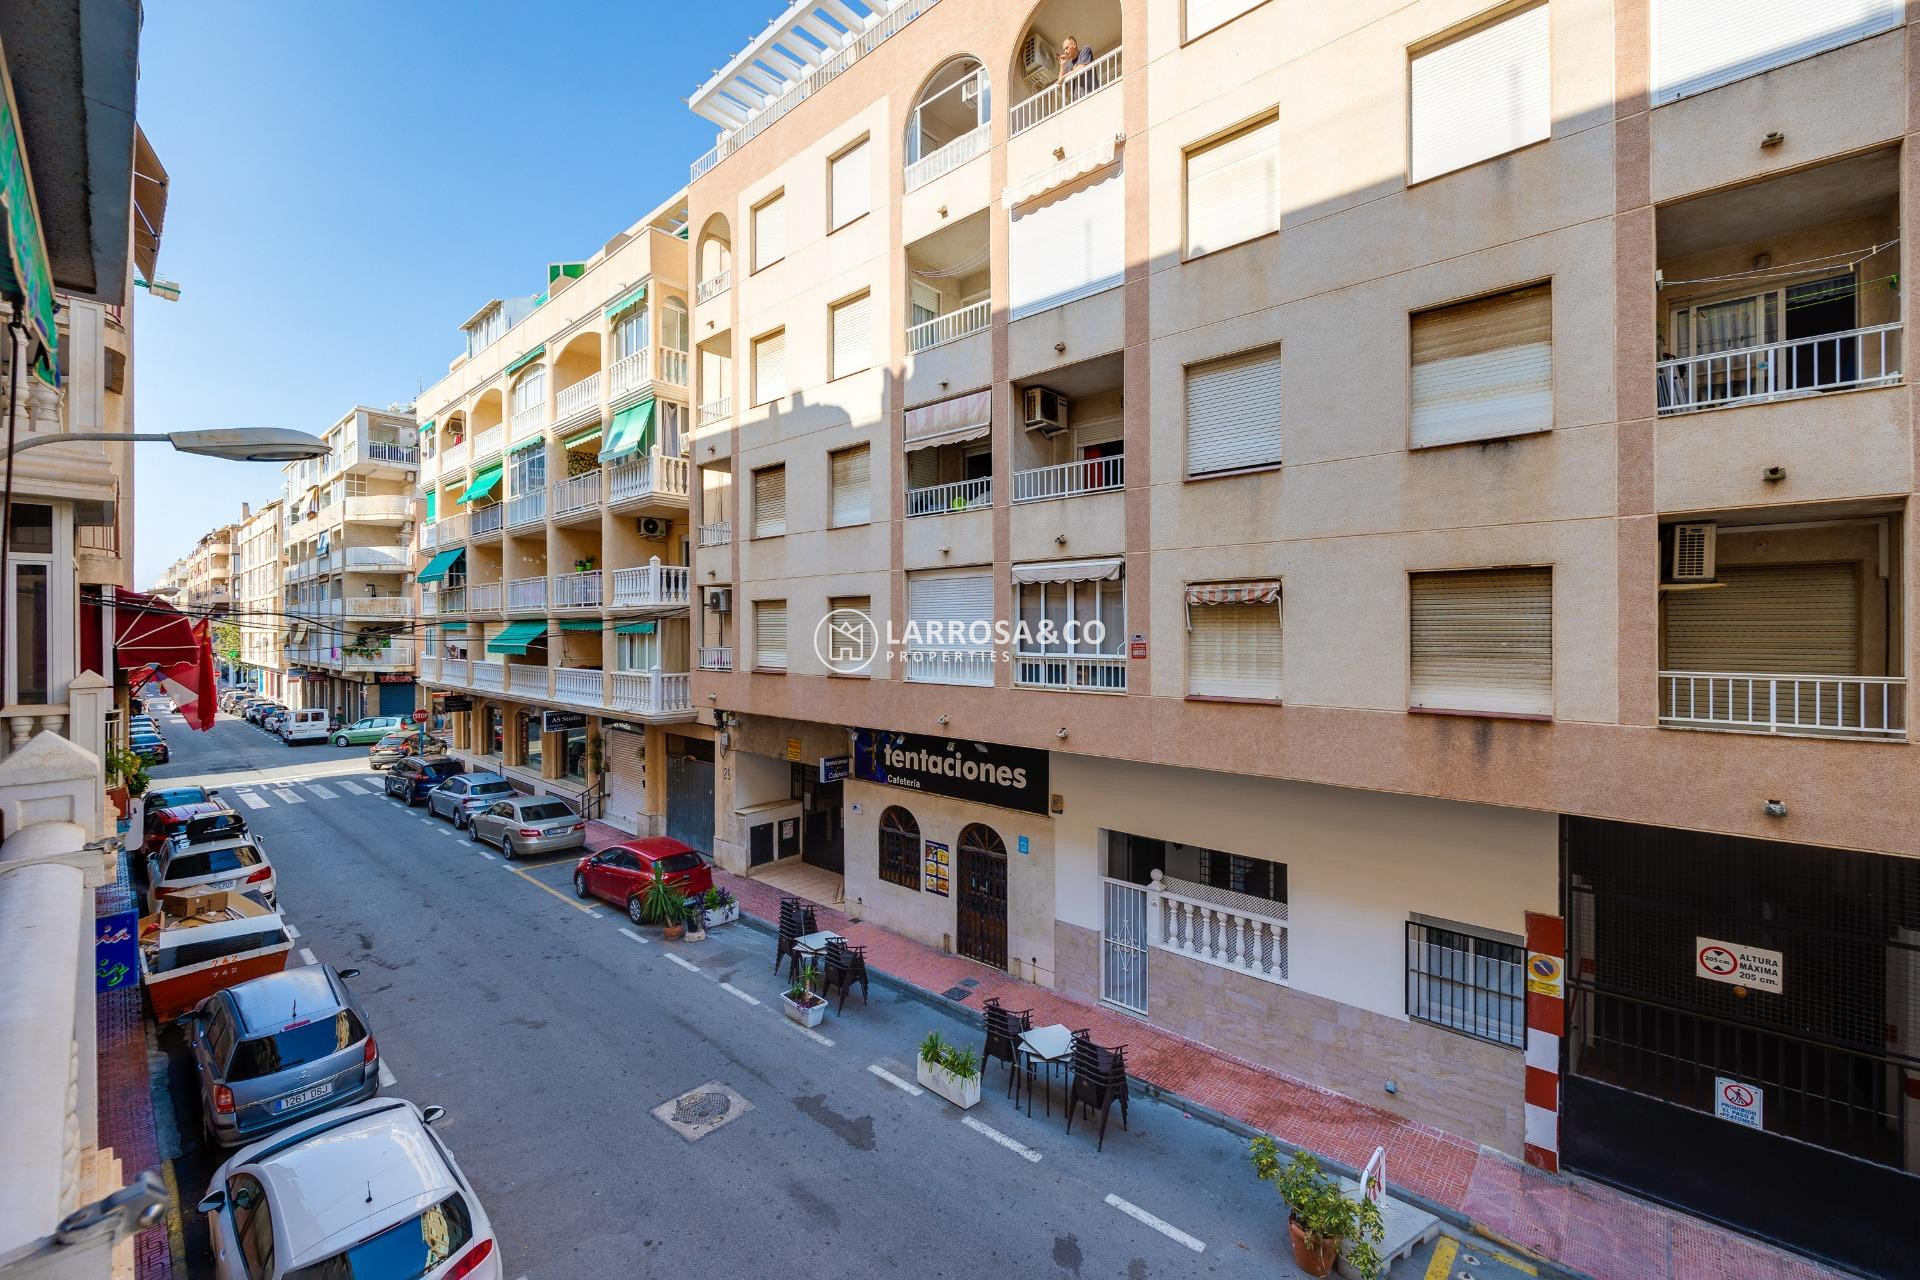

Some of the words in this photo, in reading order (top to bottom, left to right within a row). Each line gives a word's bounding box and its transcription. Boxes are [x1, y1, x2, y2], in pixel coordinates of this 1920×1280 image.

[884, 743, 1027, 789] tentaciones
[887, 774, 921, 788] Cafetería
[1739, 953, 1778, 967] ALTURA
[1739, 971, 1757, 981] 205
[1759, 977, 1778, 986] cm.
[285, 1092, 307, 1107] 1261
